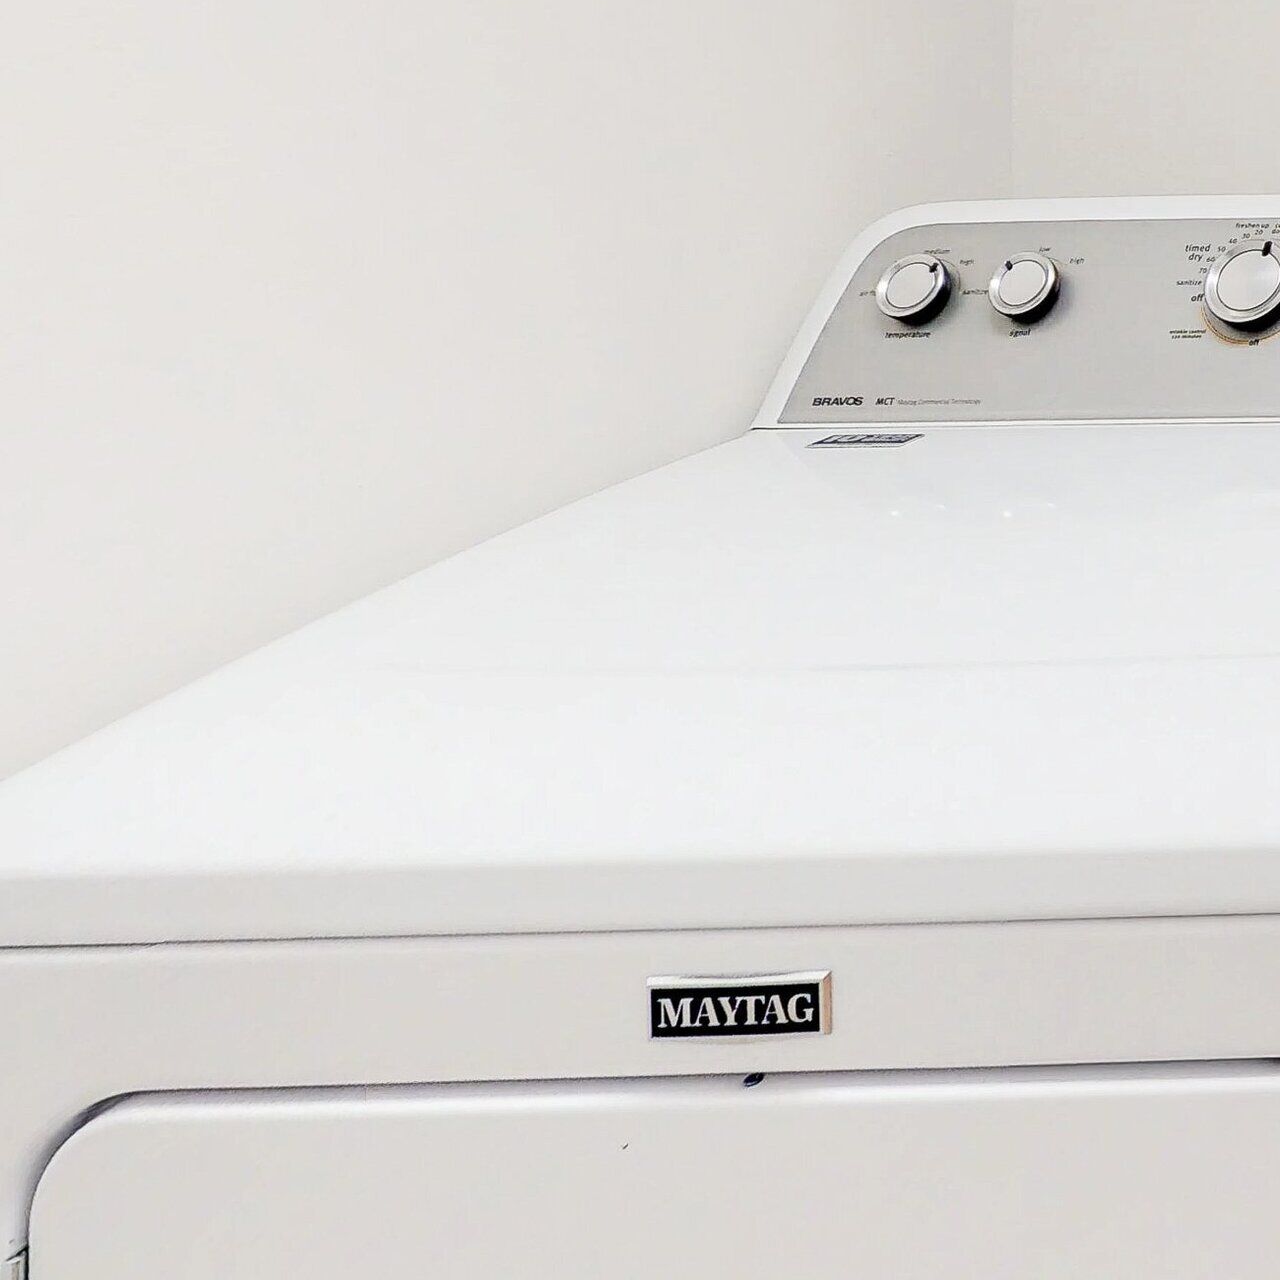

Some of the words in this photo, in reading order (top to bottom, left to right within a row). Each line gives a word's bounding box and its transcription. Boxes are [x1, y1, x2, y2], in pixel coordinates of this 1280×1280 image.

[1185, 244, 1211, 253] timed
[1188, 252, 1203, 262] dry
[1191, 293, 1205, 302] off
[885, 331, 930, 339] temperature
[1249, 339, 1260, 347] off
[812, 396, 864, 407] BRAVOS
[875, 397, 895, 406] MCT
[656, 992, 815, 1029] MAYTAG
